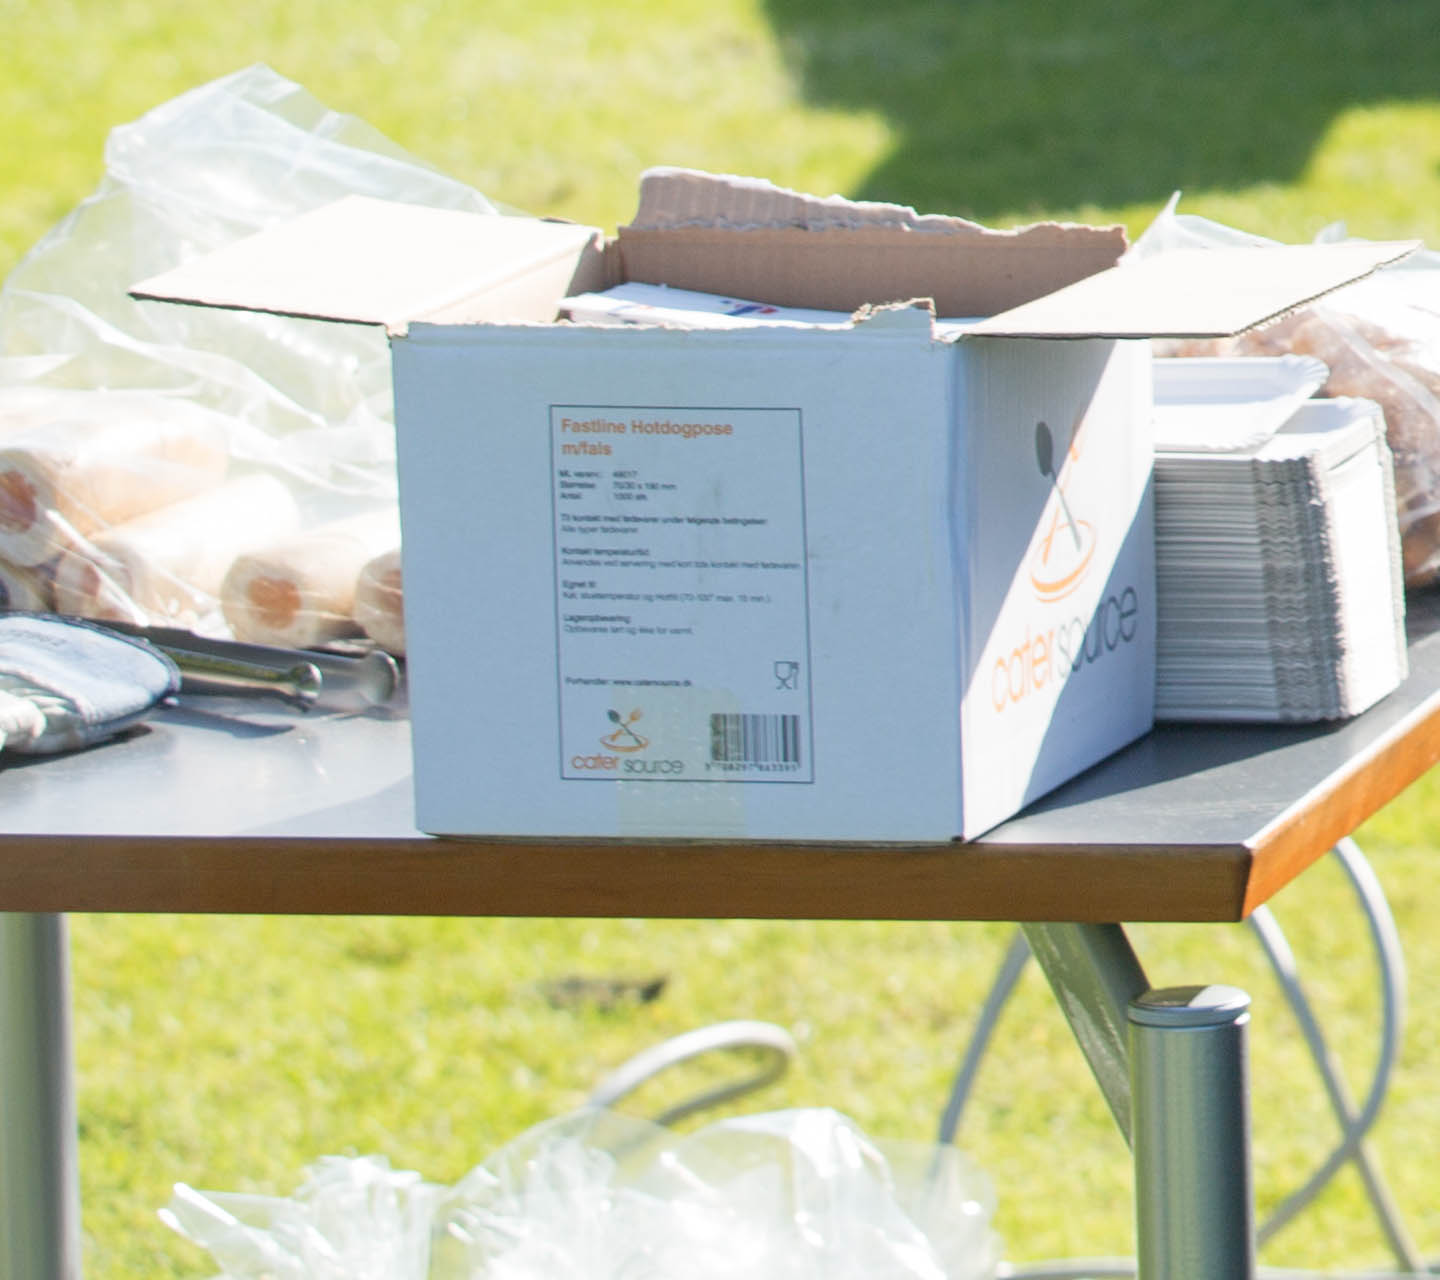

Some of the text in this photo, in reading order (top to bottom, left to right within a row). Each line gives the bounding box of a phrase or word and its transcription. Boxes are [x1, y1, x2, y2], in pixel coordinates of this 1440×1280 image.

[561, 418, 734, 438] Fastline Hotdogpose
[561, 441, 613, 456] m/fals
[992, 586, 1138, 713] cater source
[571, 752, 684, 775] cater source
